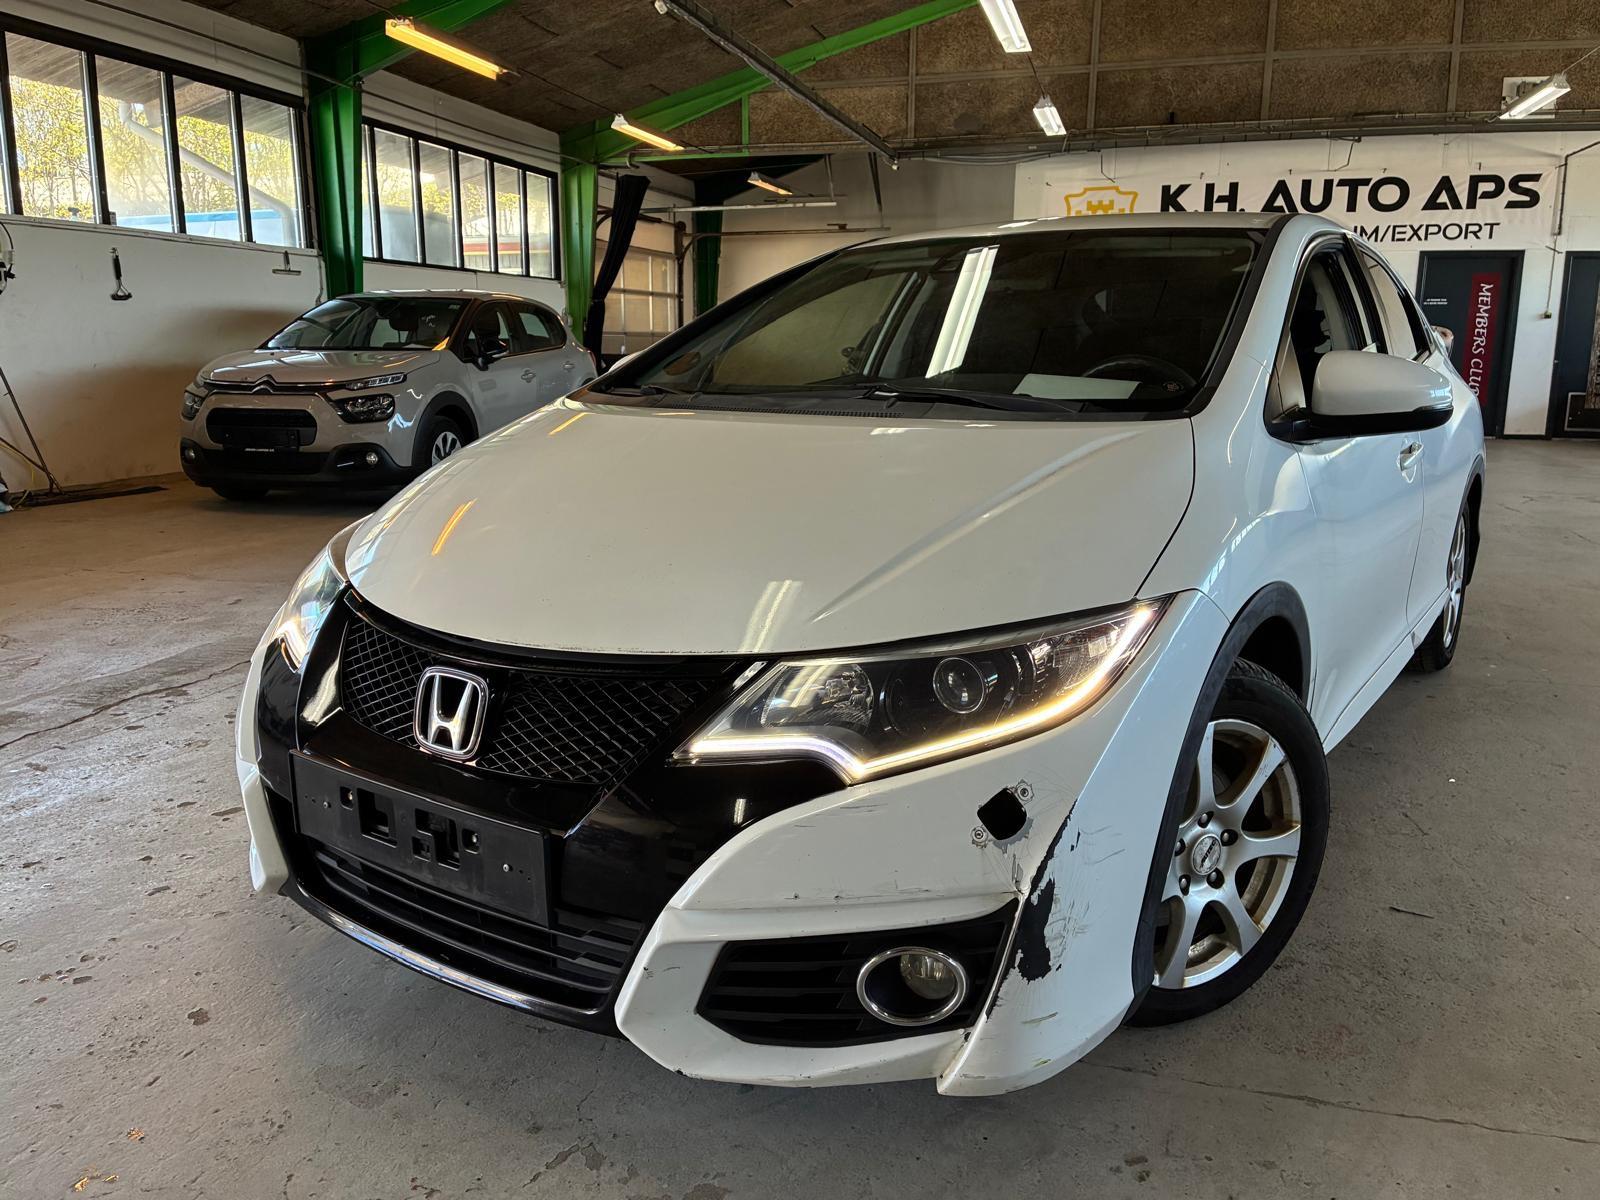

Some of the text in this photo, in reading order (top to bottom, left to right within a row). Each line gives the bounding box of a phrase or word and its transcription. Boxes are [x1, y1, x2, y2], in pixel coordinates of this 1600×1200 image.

[1160, 173, 1542, 214] KH. AUTO APS
[1471, 283, 1495, 355] MEMBERS
